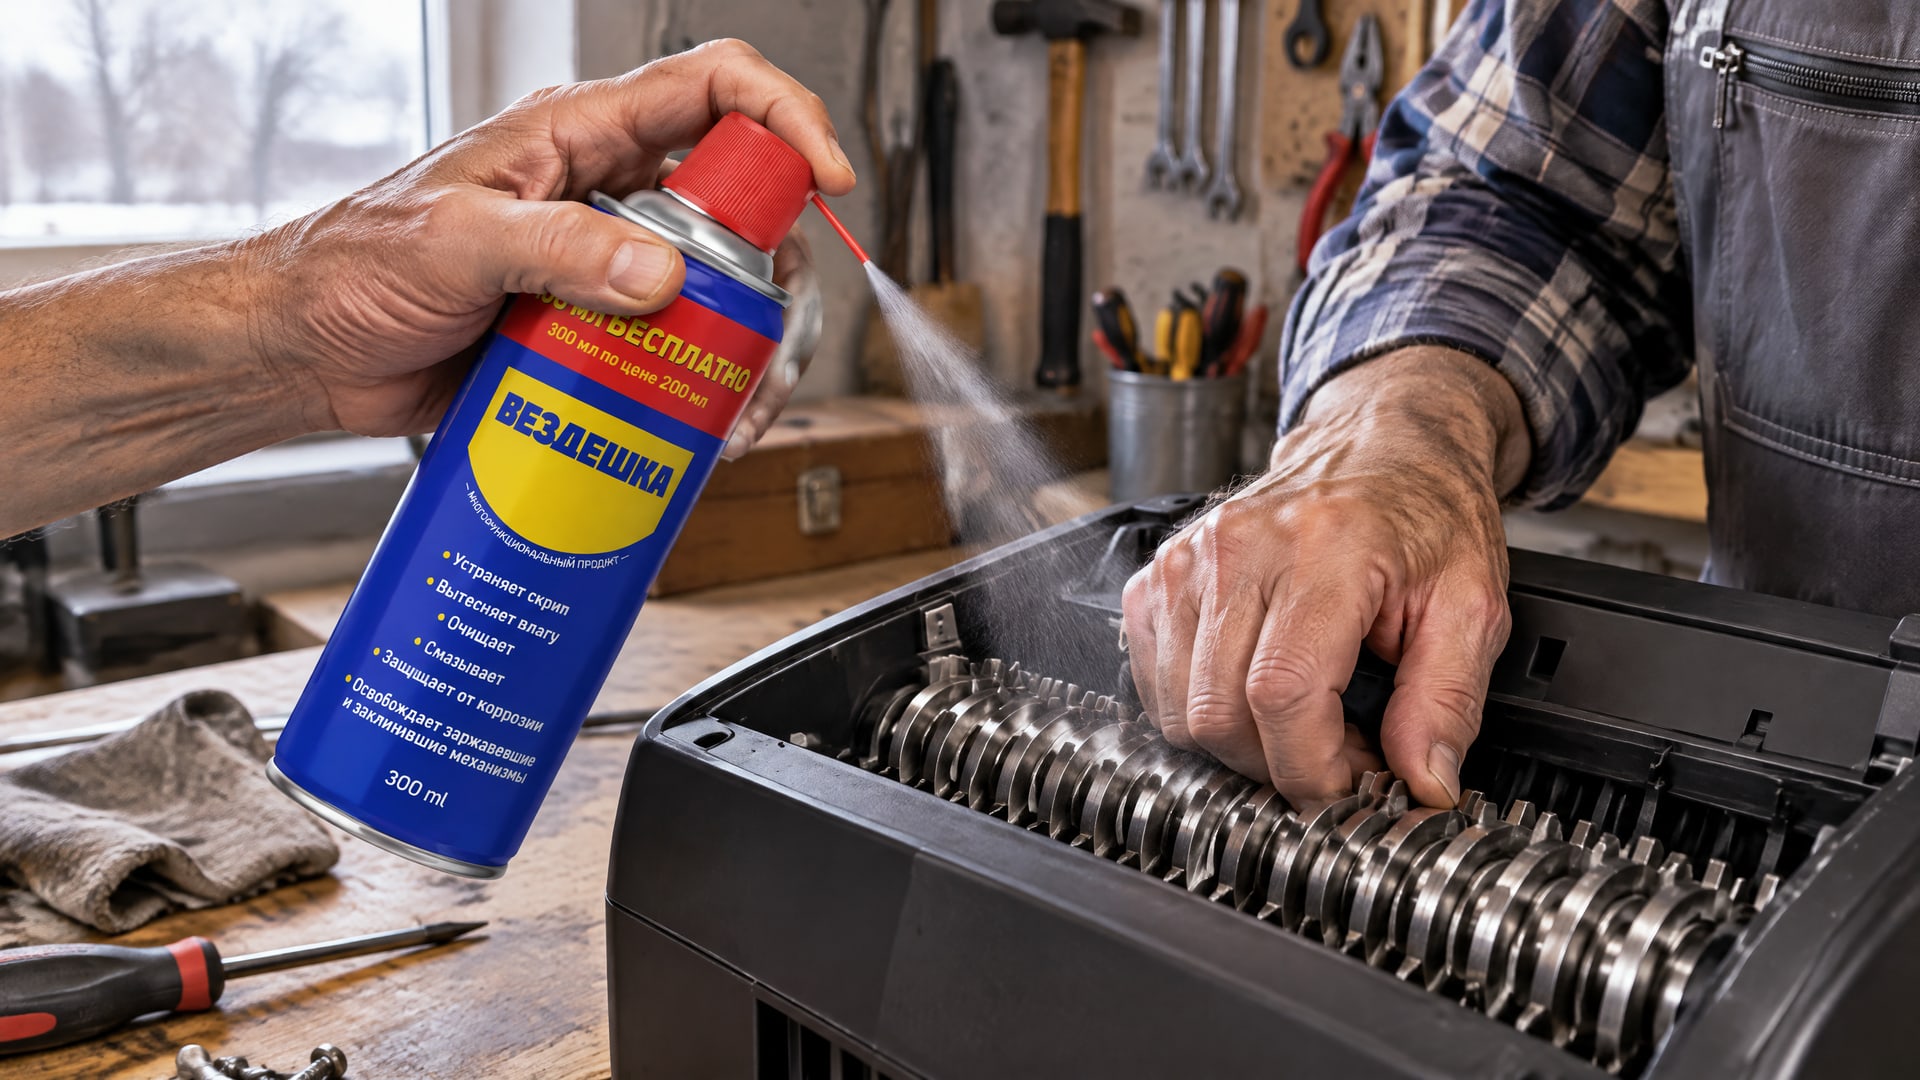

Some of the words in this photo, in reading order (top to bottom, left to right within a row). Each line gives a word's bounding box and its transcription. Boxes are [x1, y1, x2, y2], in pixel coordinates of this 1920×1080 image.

[548, 323, 577, 344] 300
[577, 340, 599, 356] мл
[600, 351, 619, 365] по
[620, 361, 657, 384] цене
[659, 376, 689, 398] 200
[689, 393, 708, 408] мл
[606, 315, 751, 393] БЕСПЛАТНО
[495, 392, 674, 498] ВЕЗДЕШКА
[436, 579, 516, 624] Вытесняет
[517, 619, 560, 644] влагу
[453, 552, 526, 597] Устраняет
[528, 592, 569, 615] скрип
[424, 641, 505, 685] Смазывает
[448, 616, 515, 655] Очищает
[342, 697, 353, 709] и
[353, 703, 447, 755] заклинившие
[449, 742, 527, 783] механизмы
[353, 678, 442, 731] Освобождает
[443, 726, 536, 767] заржавевшие
[457, 692, 476, 705] от
[477, 700, 544, 732] коррозии
[385, 770, 422, 796] 300
[424, 790, 448, 807] ml
